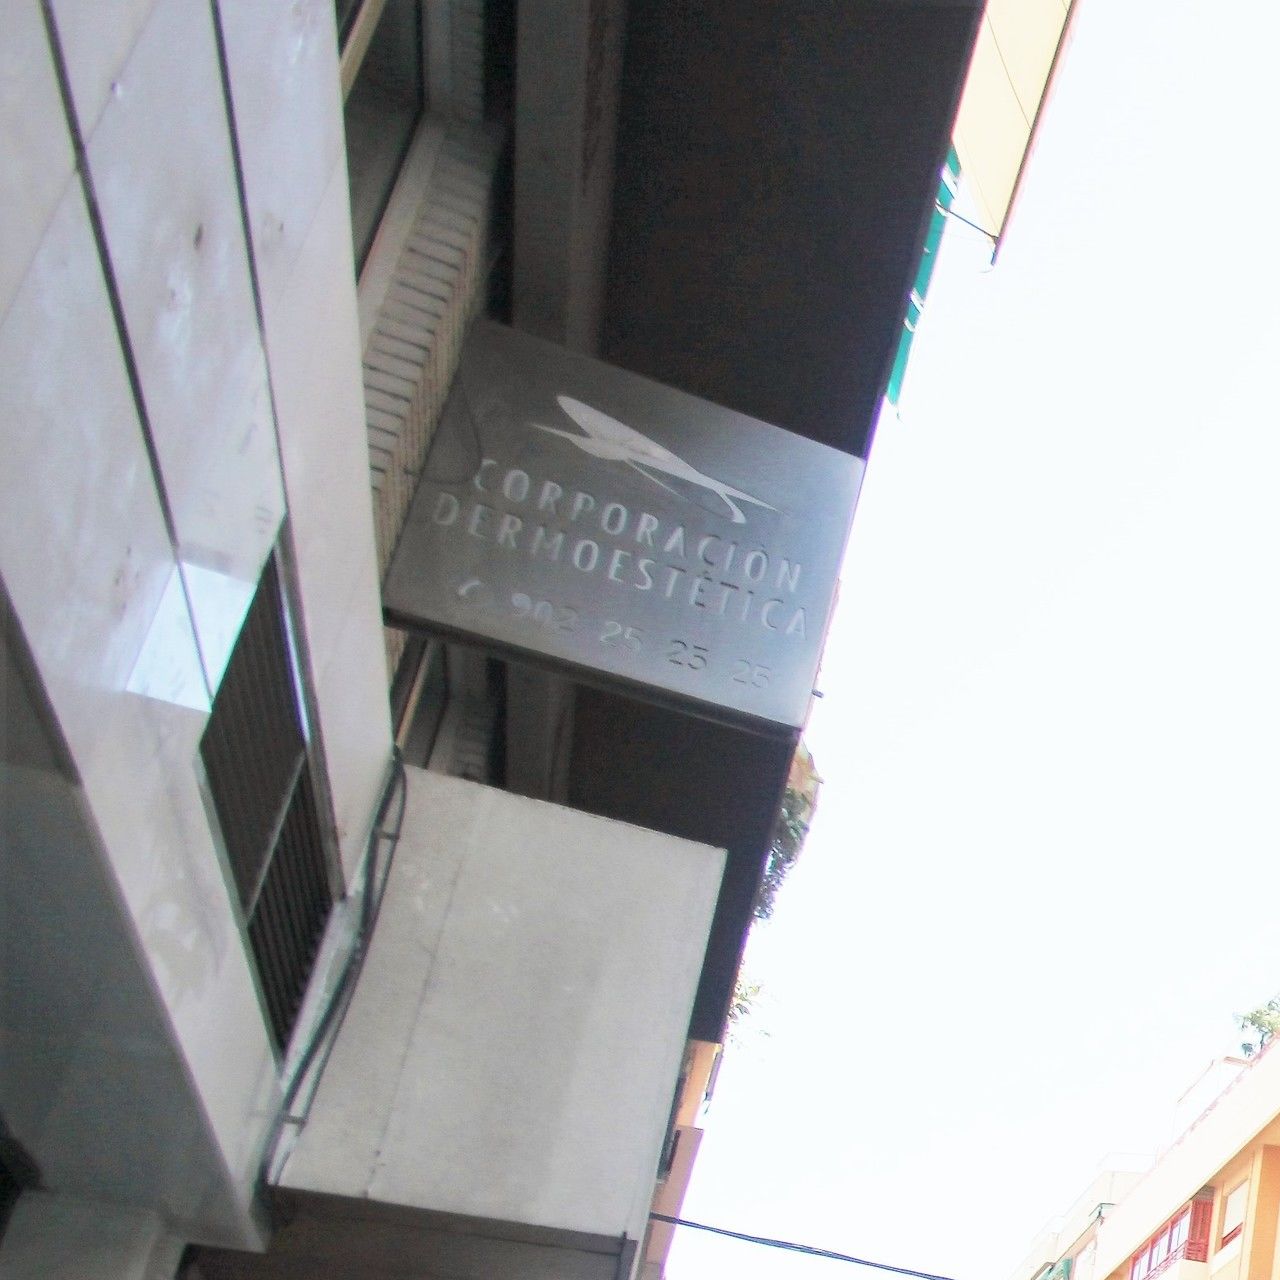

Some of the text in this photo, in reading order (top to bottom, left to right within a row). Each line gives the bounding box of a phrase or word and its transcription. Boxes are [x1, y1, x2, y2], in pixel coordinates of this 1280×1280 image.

[599, 621, 645, 654] 25
[668, 639, 708, 672] 25
[732, 658, 773, 690] 25
